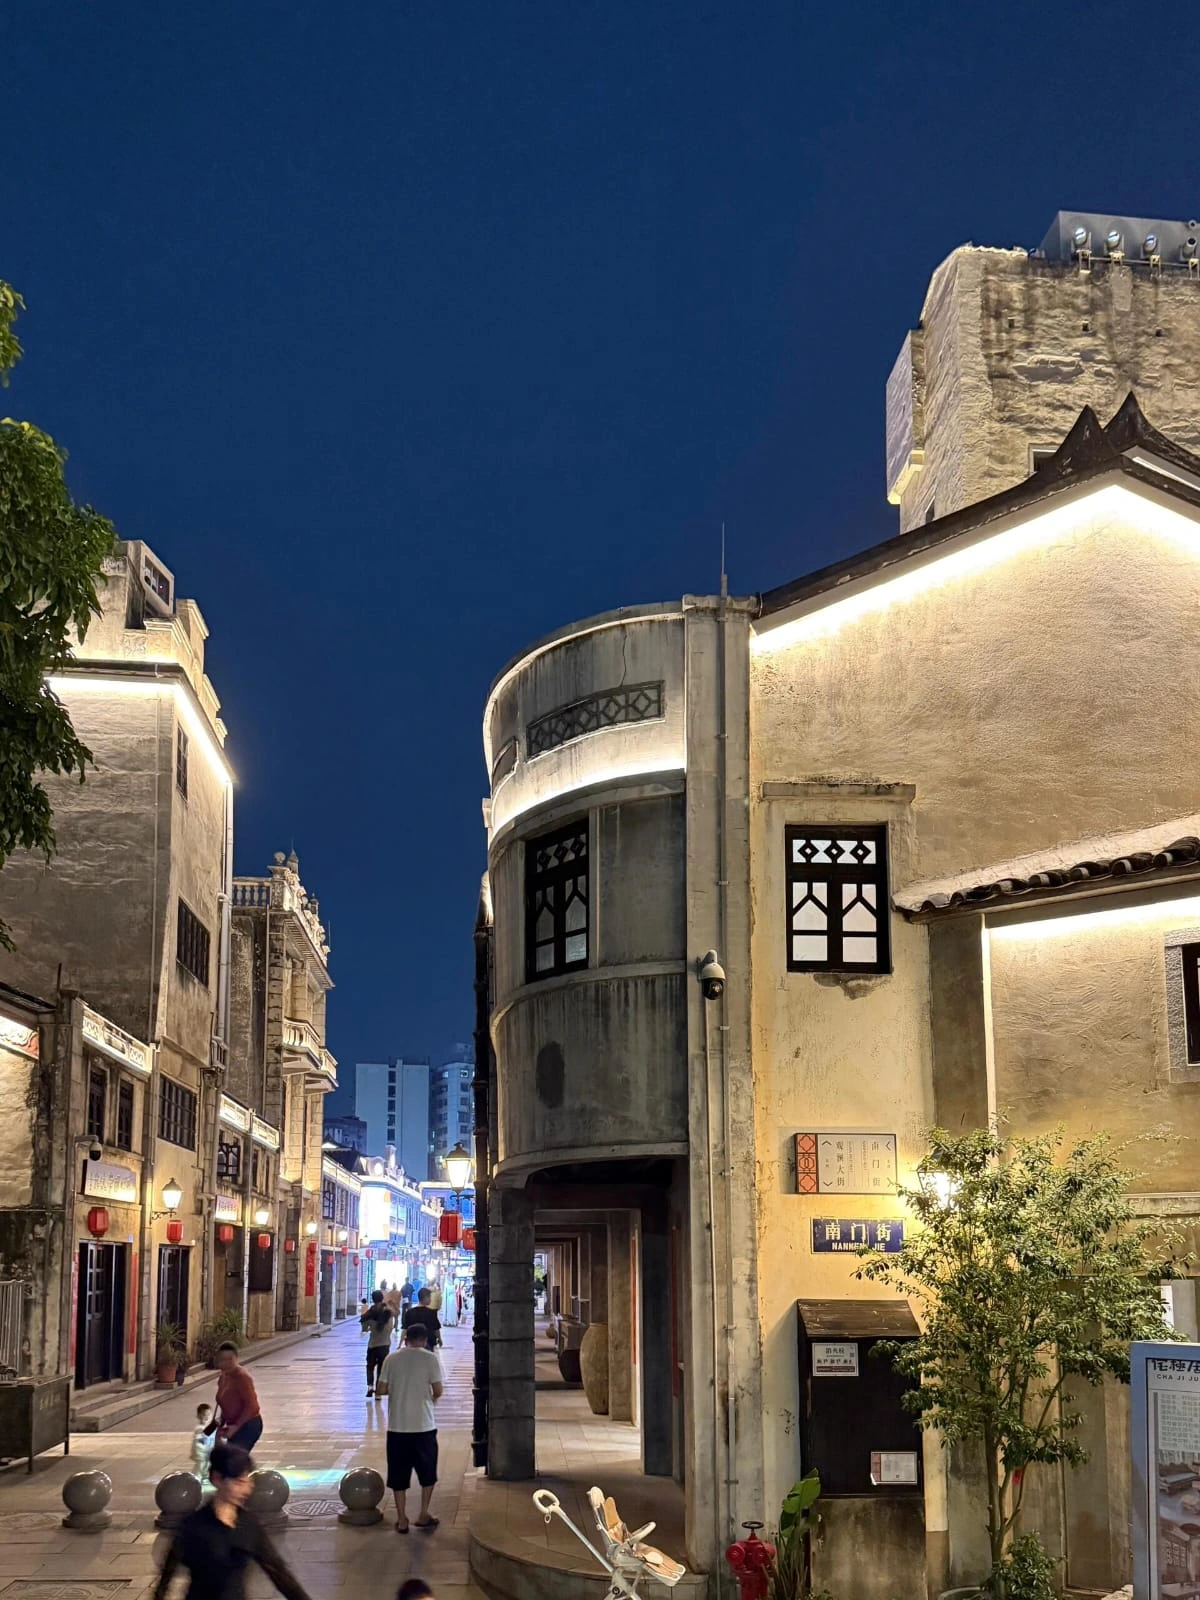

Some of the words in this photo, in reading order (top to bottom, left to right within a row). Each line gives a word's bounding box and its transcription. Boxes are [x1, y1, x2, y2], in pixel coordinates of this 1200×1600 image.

[825, 1222, 892, 1242] 南门街
[872, 1243, 886, 1251] JIE
